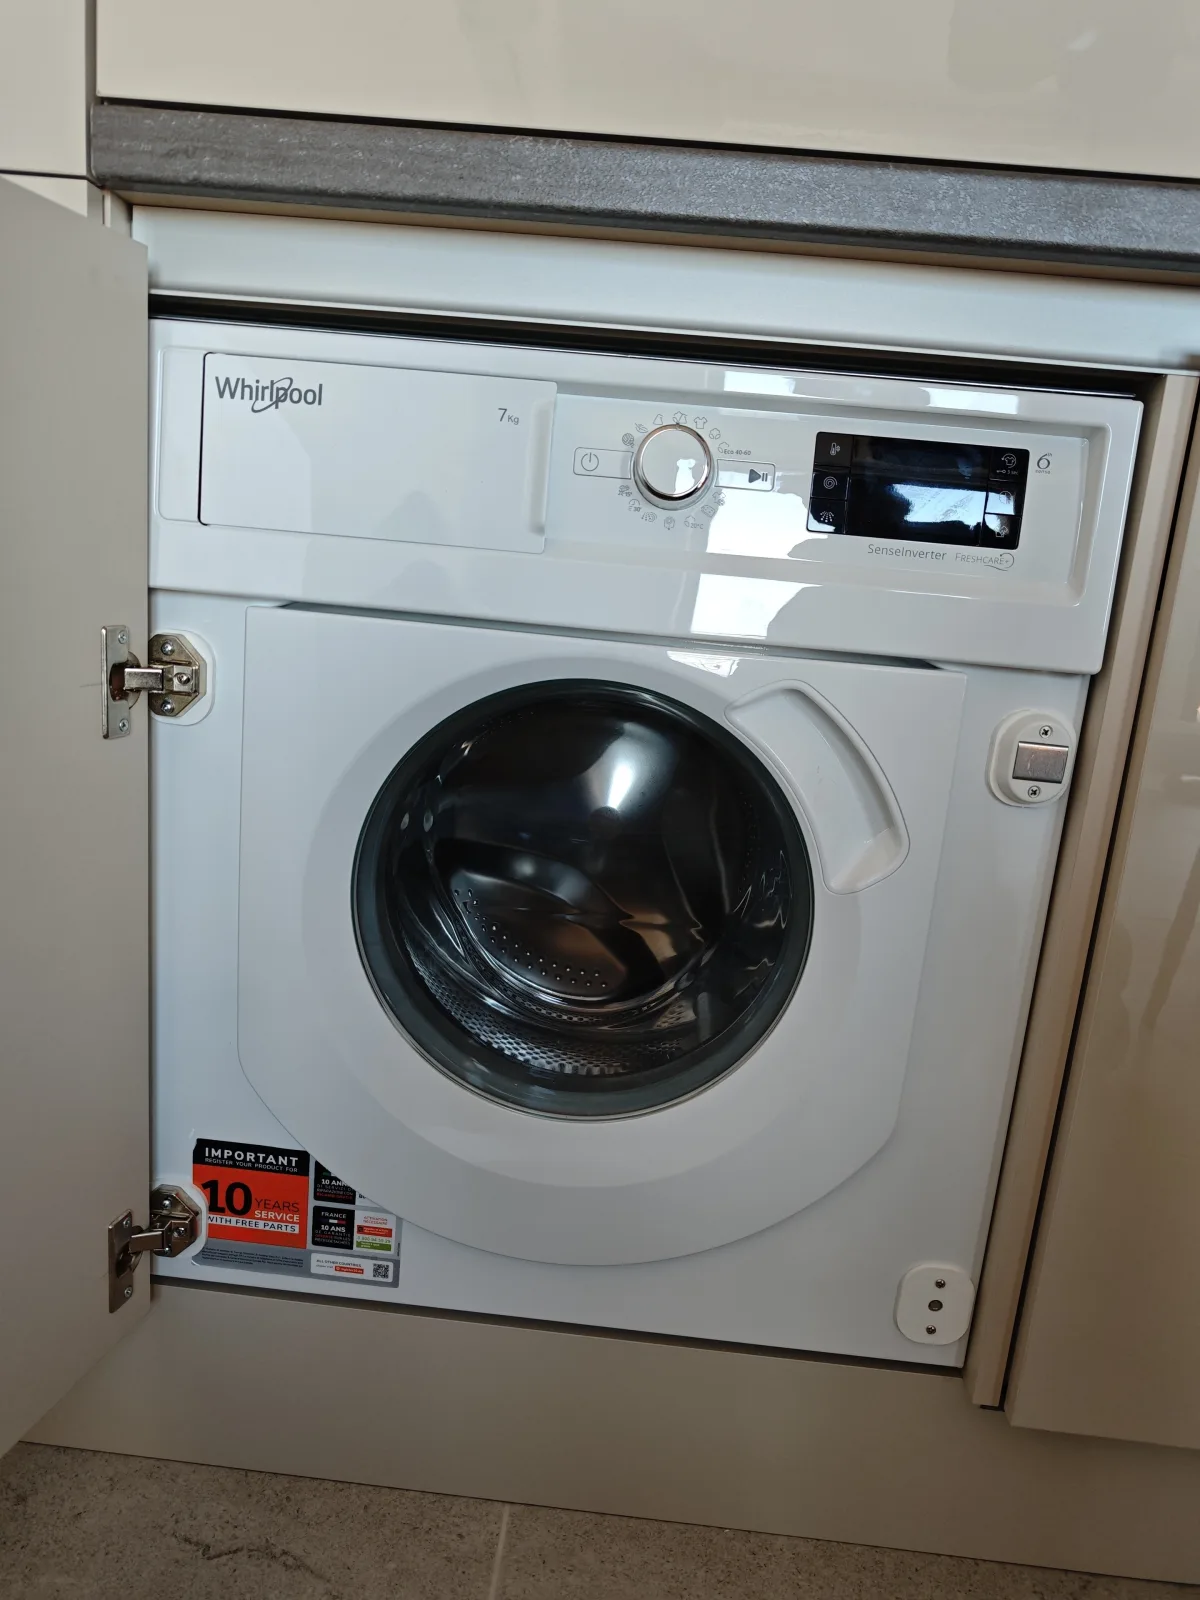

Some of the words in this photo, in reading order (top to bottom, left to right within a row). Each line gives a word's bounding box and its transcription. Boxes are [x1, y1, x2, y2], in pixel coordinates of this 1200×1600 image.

[214, 376, 323, 412] Whirlpool
[867, 543, 947, 561] SenseInverter
[205, 1147, 298, 1167] IMPORTANT
[205, 1157, 233, 1165] REGISTER
[255, 1163, 283, 1171] PRODUCT
[201, 1179, 253, 1216] 10
[255, 1198, 300, 1213] YEARS
[254, 1210, 300, 1222] SERVICE
[321, 1211, 347, 1219] FRANCE
[235, 1218, 260, 1228] FREE
[263, 1222, 296, 1232] PARTS
[330, 1225, 346, 1233] ANS
